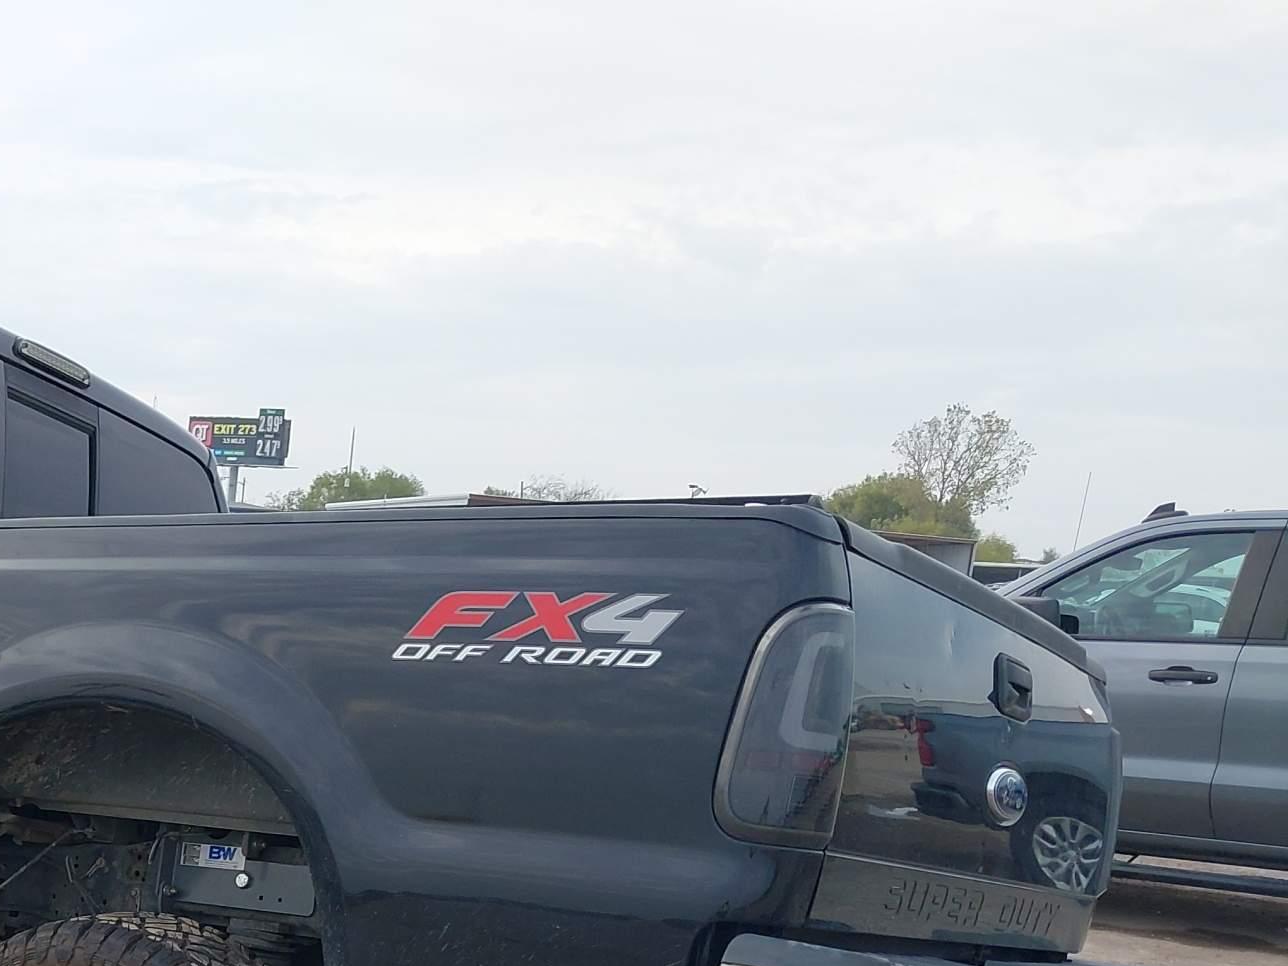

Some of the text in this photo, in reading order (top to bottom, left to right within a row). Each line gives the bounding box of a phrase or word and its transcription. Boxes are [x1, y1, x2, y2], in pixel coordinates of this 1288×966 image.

[214, 423, 257, 435] EXIT 273
[403, 590, 686, 645] FX4
[392, 643, 662, 668] OFF ROAD
[884, 878, 1062, 937] SUPER DUTY
